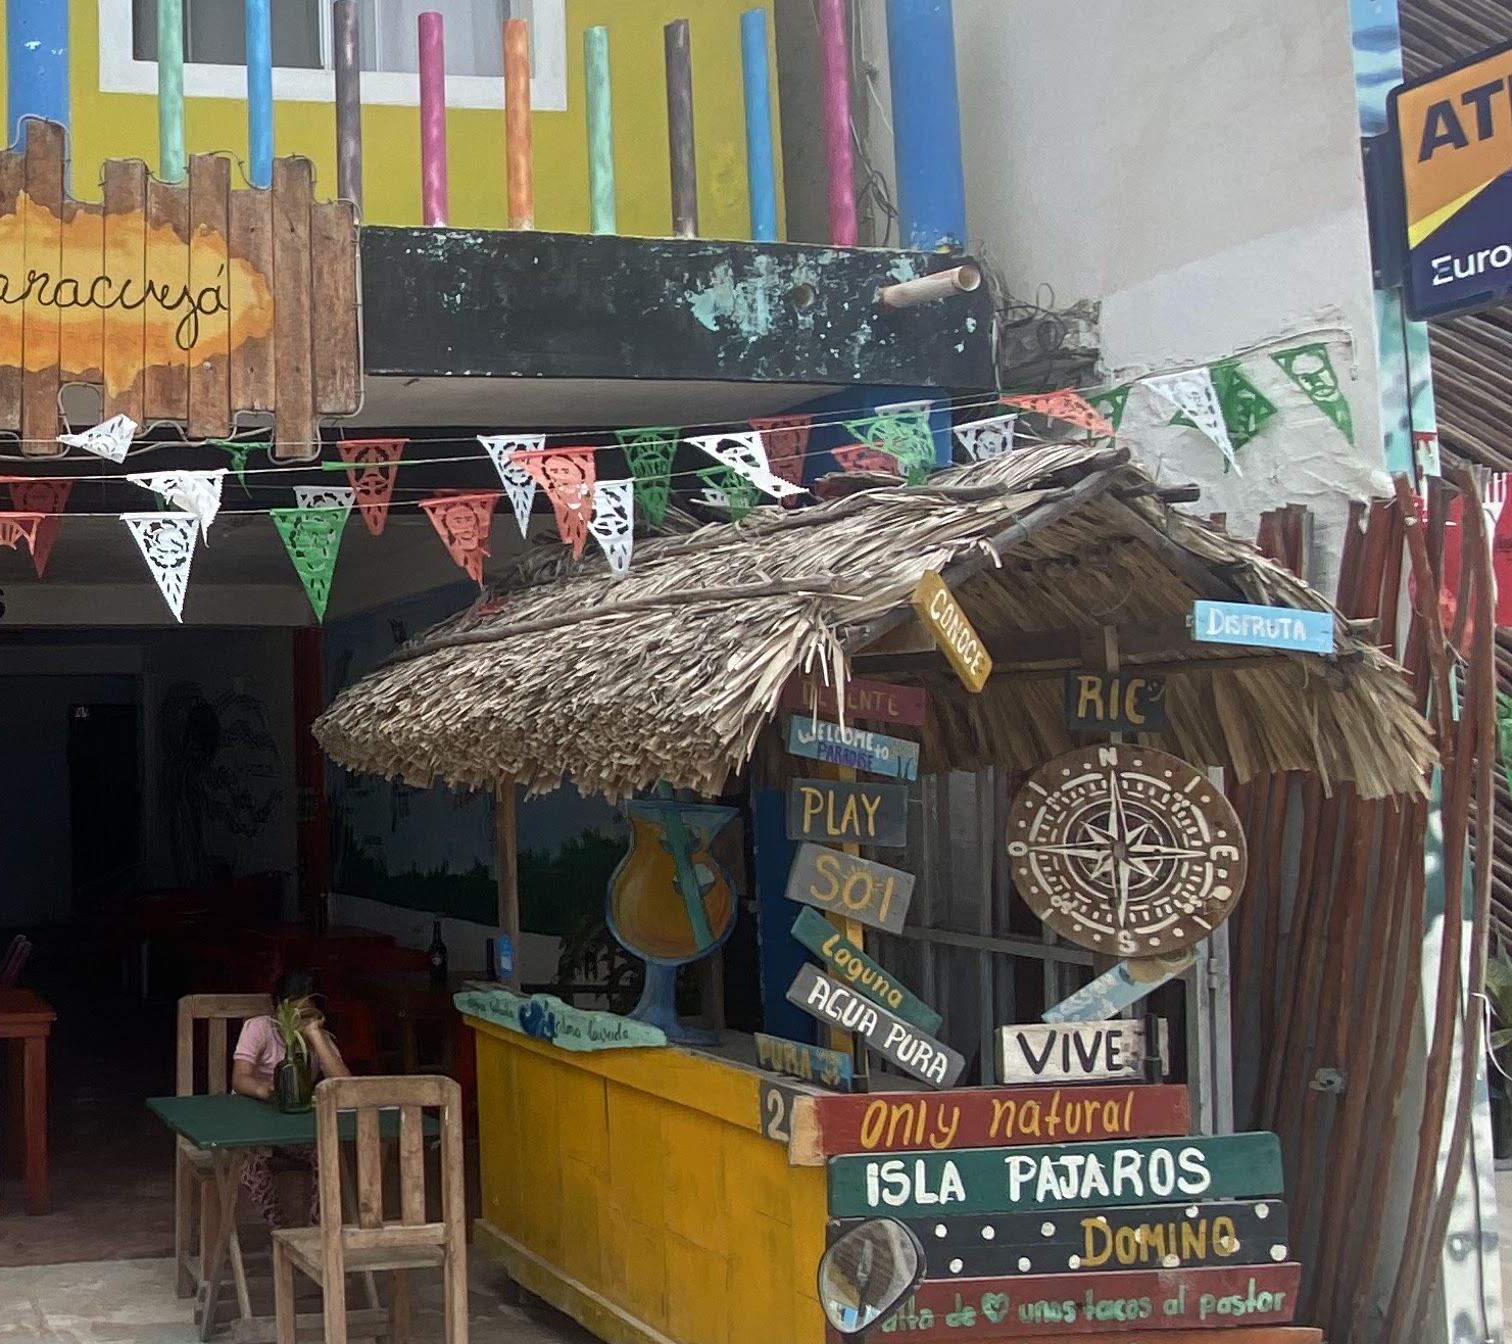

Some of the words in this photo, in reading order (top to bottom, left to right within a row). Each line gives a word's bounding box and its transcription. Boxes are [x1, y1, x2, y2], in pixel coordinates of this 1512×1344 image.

[1417, 73, 1512, 165] AT
[930, 588, 985, 675] CONOCE
[1207, 607, 1307, 641] DISFRUTA
[1098, 747, 1118, 767] N
[800, 787, 881, 837] PLAY
[1210, 845, 1239, 861] E
[1117, 930, 1137, 953] S
[822, 934, 904, 1008] Laguna
[807, 975, 878, 1037] AGUA
[883, 1023, 949, 1084] PURA
[1016, 1030, 1122, 1075] VIVE
[990, 1090, 1135, 1138] natural
[866, 1159, 966, 1207] ISLA
[1004, 1147, 1212, 1203] PAJAROS
[1080, 1216, 1236, 1266] DOMINO
[882, 1294, 935, 1333] alta
[945, 1292, 977, 1327] de
[1083, 1289, 1153, 1321] tacos
[1163, 1284, 1186, 1315] al
[1200, 1277, 1287, 1320] pastor
